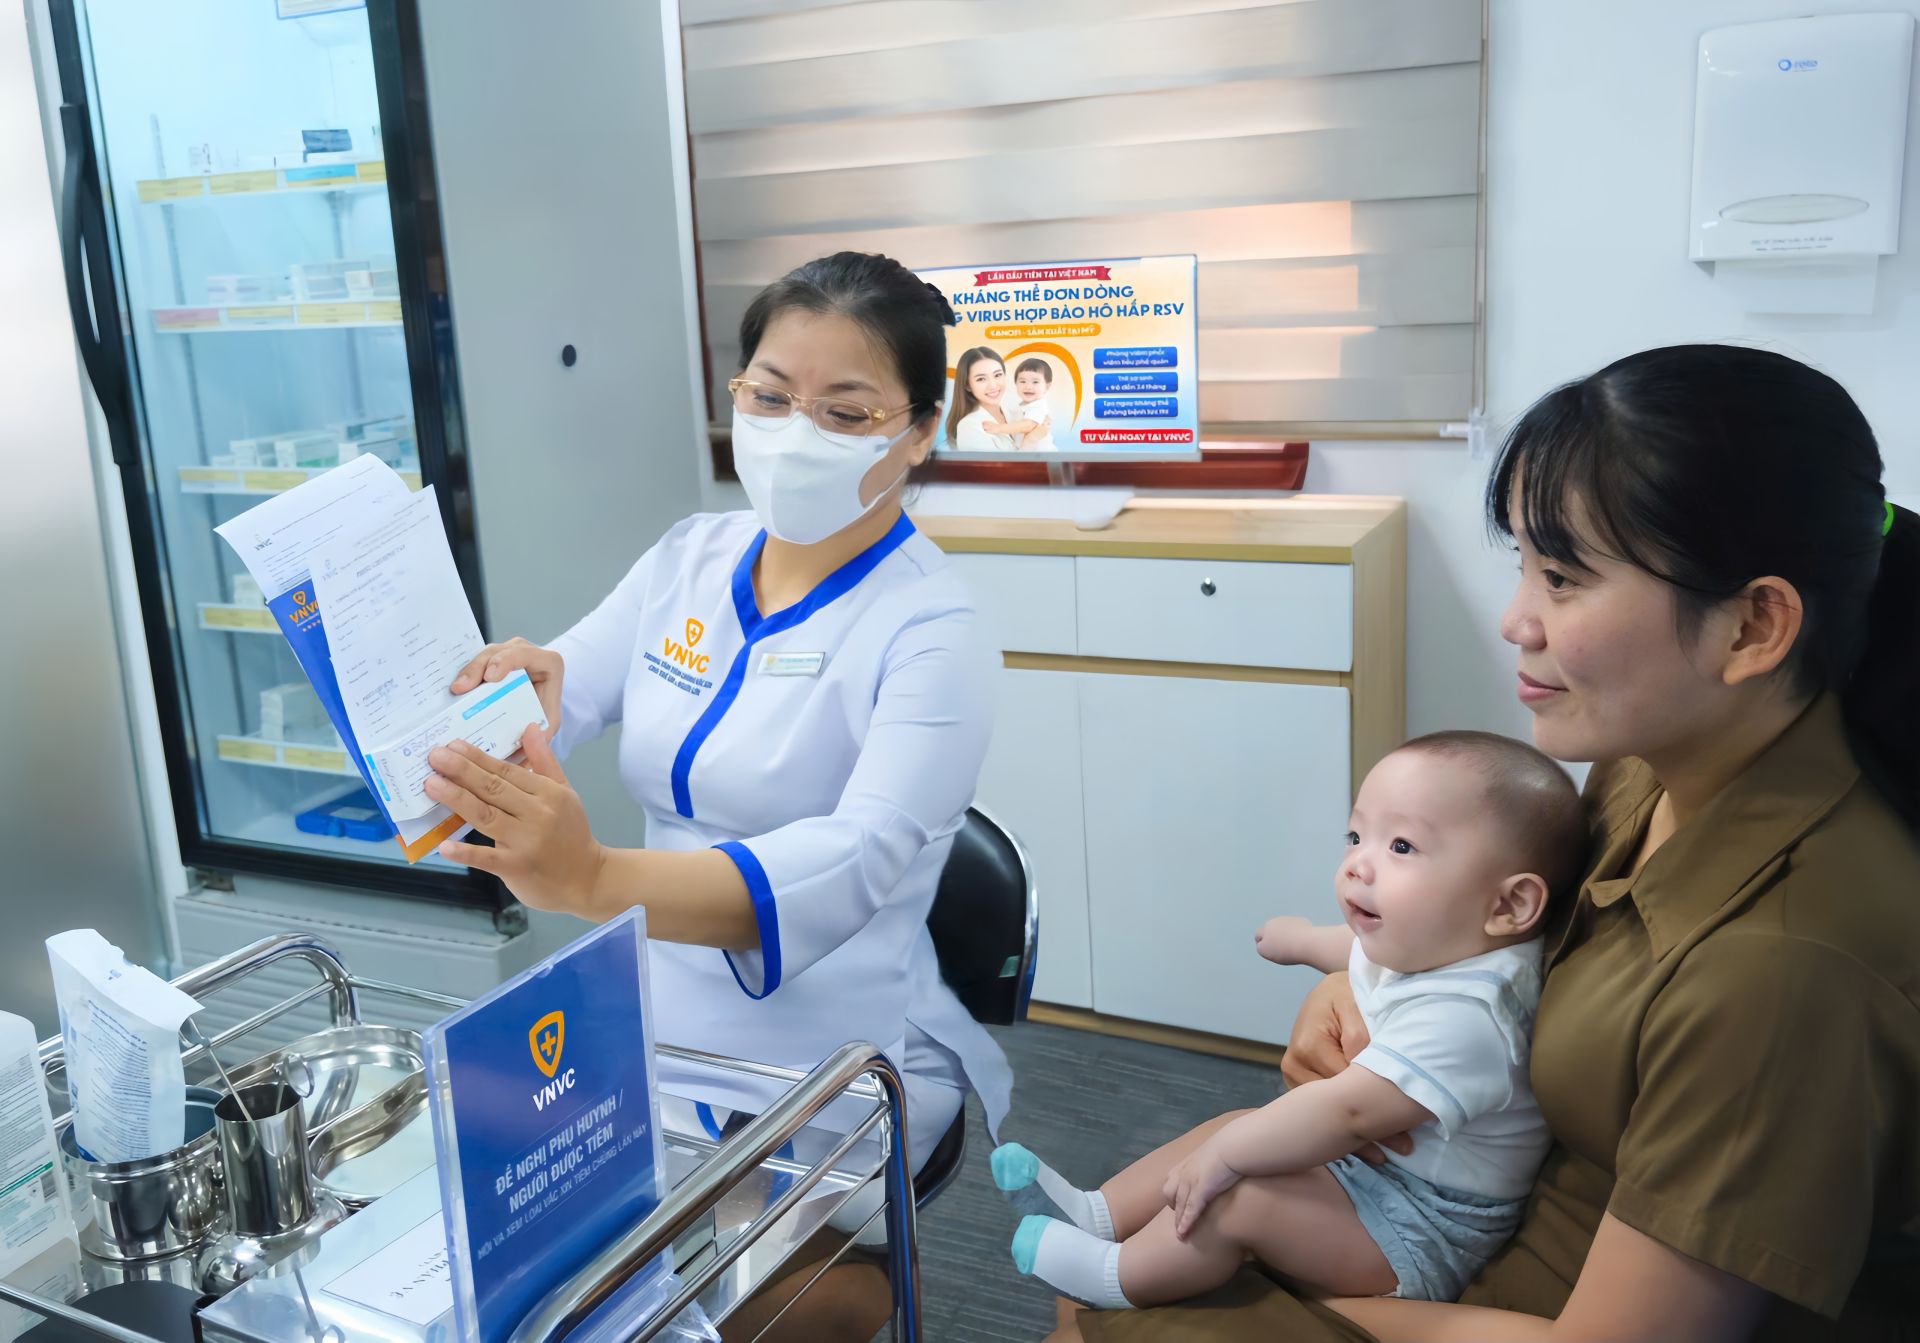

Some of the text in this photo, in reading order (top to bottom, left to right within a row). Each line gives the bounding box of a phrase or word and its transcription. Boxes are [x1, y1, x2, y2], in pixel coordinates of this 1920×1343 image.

[953, 284, 1134, 305] KHÁNG THỂ ĐƠN DÒNG
[967, 309, 1011, 323] VIRUS
[1015, 308, 1048, 324] HỢP
[1051, 304, 1085, 320] BÀO
[1089, 304, 1113, 318] HÔ
[1117, 299, 1150, 317] HẤP
[1154, 303, 1184, 316] RSV
[1119, 432, 1146, 440] NGAY
[1163, 432, 1191, 441] VNVC
[664, 637, 710, 673] VNVC
[533, 1068, 576, 1112] VNVC
[495, 1163, 514, 1196] ĐỀ
[517, 1146, 547, 1181] NGHỊ
[549, 1124, 574, 1156] PHỤ
[577, 1094, 617, 1137] HUYNH
[509, 1122, 614, 1214] NGƯỜI ĐƯỢC TIÊM
